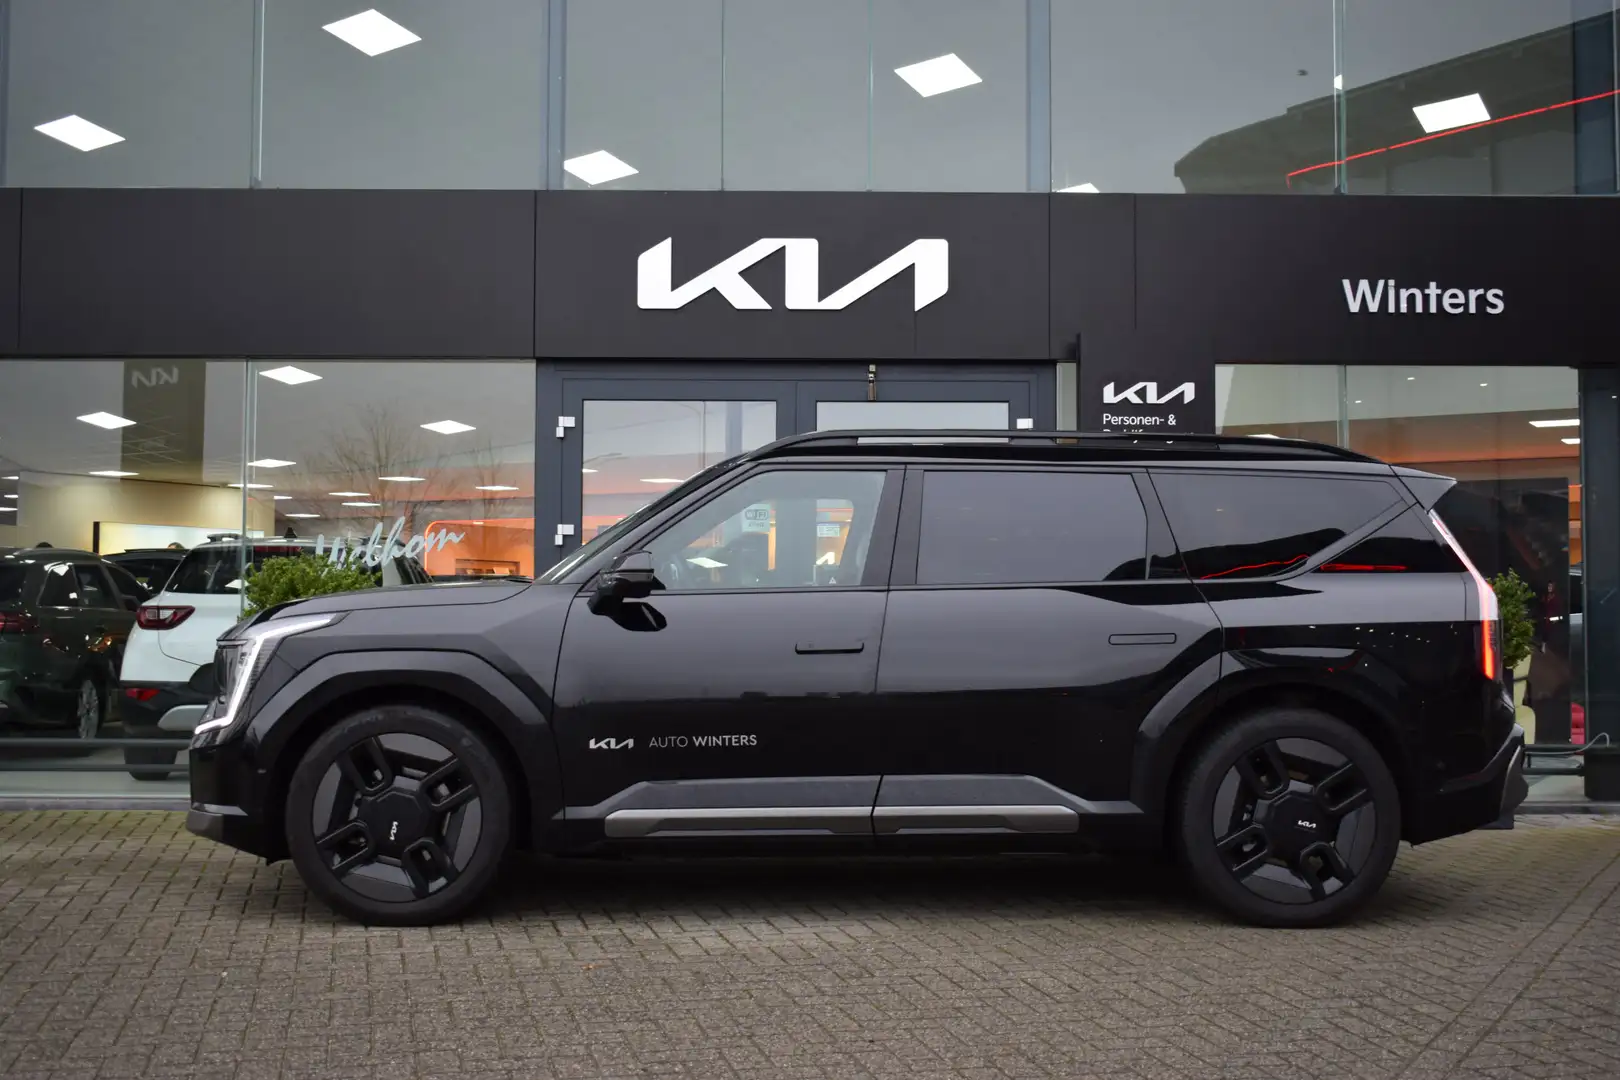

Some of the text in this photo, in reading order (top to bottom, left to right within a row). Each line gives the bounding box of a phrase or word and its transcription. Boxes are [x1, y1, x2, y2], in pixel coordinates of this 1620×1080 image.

[636, 236, 949, 312] KIA
[1341, 278, 1505, 315] Winters
[1102, 381, 1196, 405] KIA
[1102, 413, 1177, 426] Personen- &
[588, 734, 758, 750] KIA AUTO WINTERS
[1297, 819, 1317, 829] KIA
